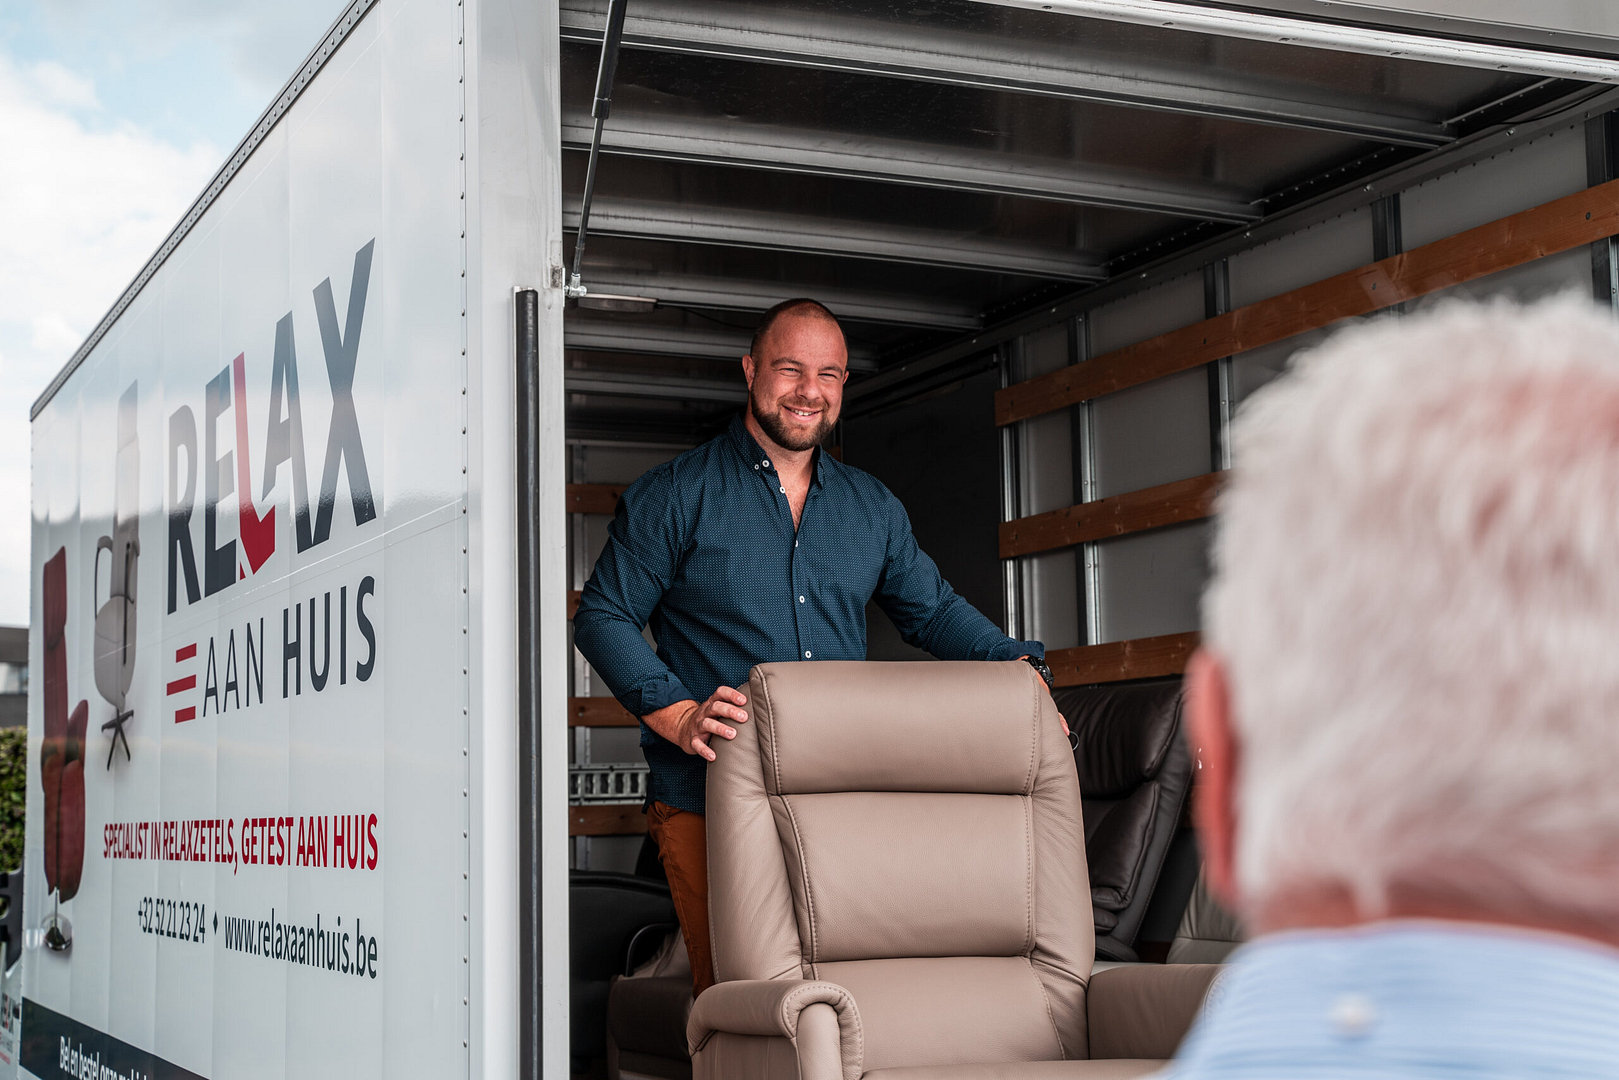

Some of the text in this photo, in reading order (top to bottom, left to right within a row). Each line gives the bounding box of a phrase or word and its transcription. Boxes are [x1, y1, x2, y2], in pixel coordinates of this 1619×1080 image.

[167, 236, 377, 616] RELAX
[203, 574, 377, 718] AAN HUIS
[103, 813, 379, 876] SPECIALIST IN RELAXZETELS, GETEST AAN HUIS
[224, 907, 379, 980] www.relaxaanhuis.be
[60, 1035, 71, 1073] Bel
[71, 1048, 79, 1078] en
